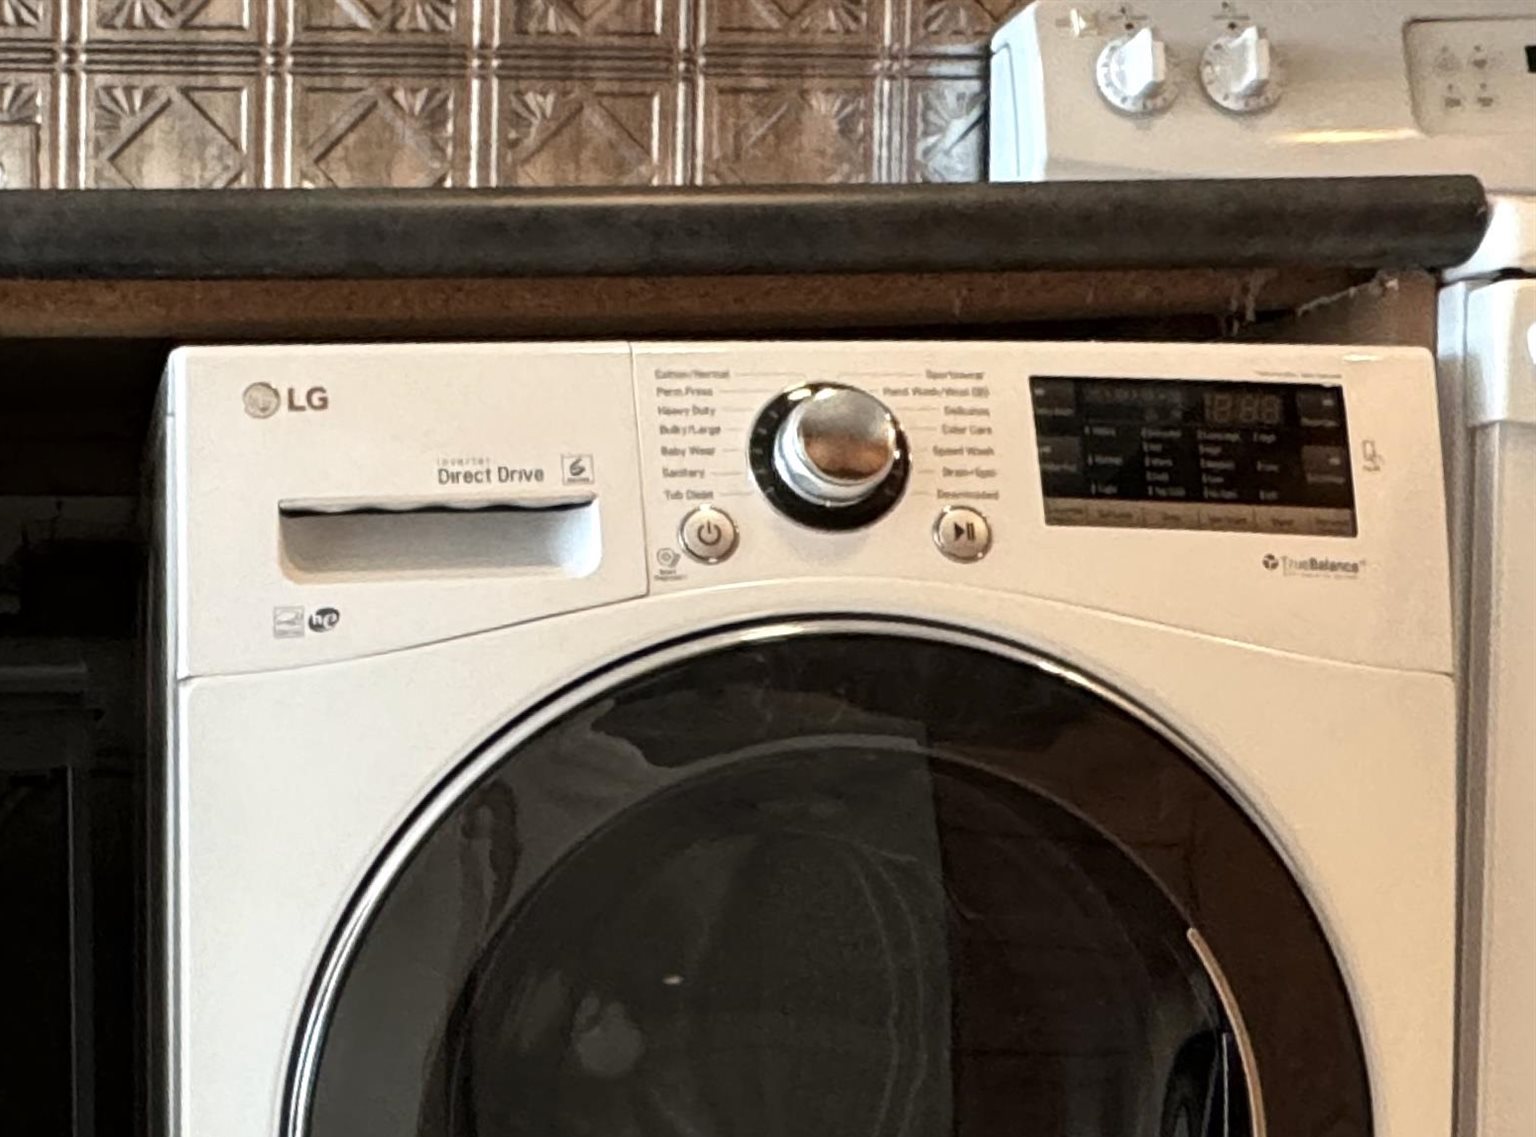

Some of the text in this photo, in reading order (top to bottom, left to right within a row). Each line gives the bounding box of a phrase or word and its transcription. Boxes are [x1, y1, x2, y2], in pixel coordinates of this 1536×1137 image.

[287, 386, 330, 412] LG
[437, 465, 545, 485] Direct Drive
